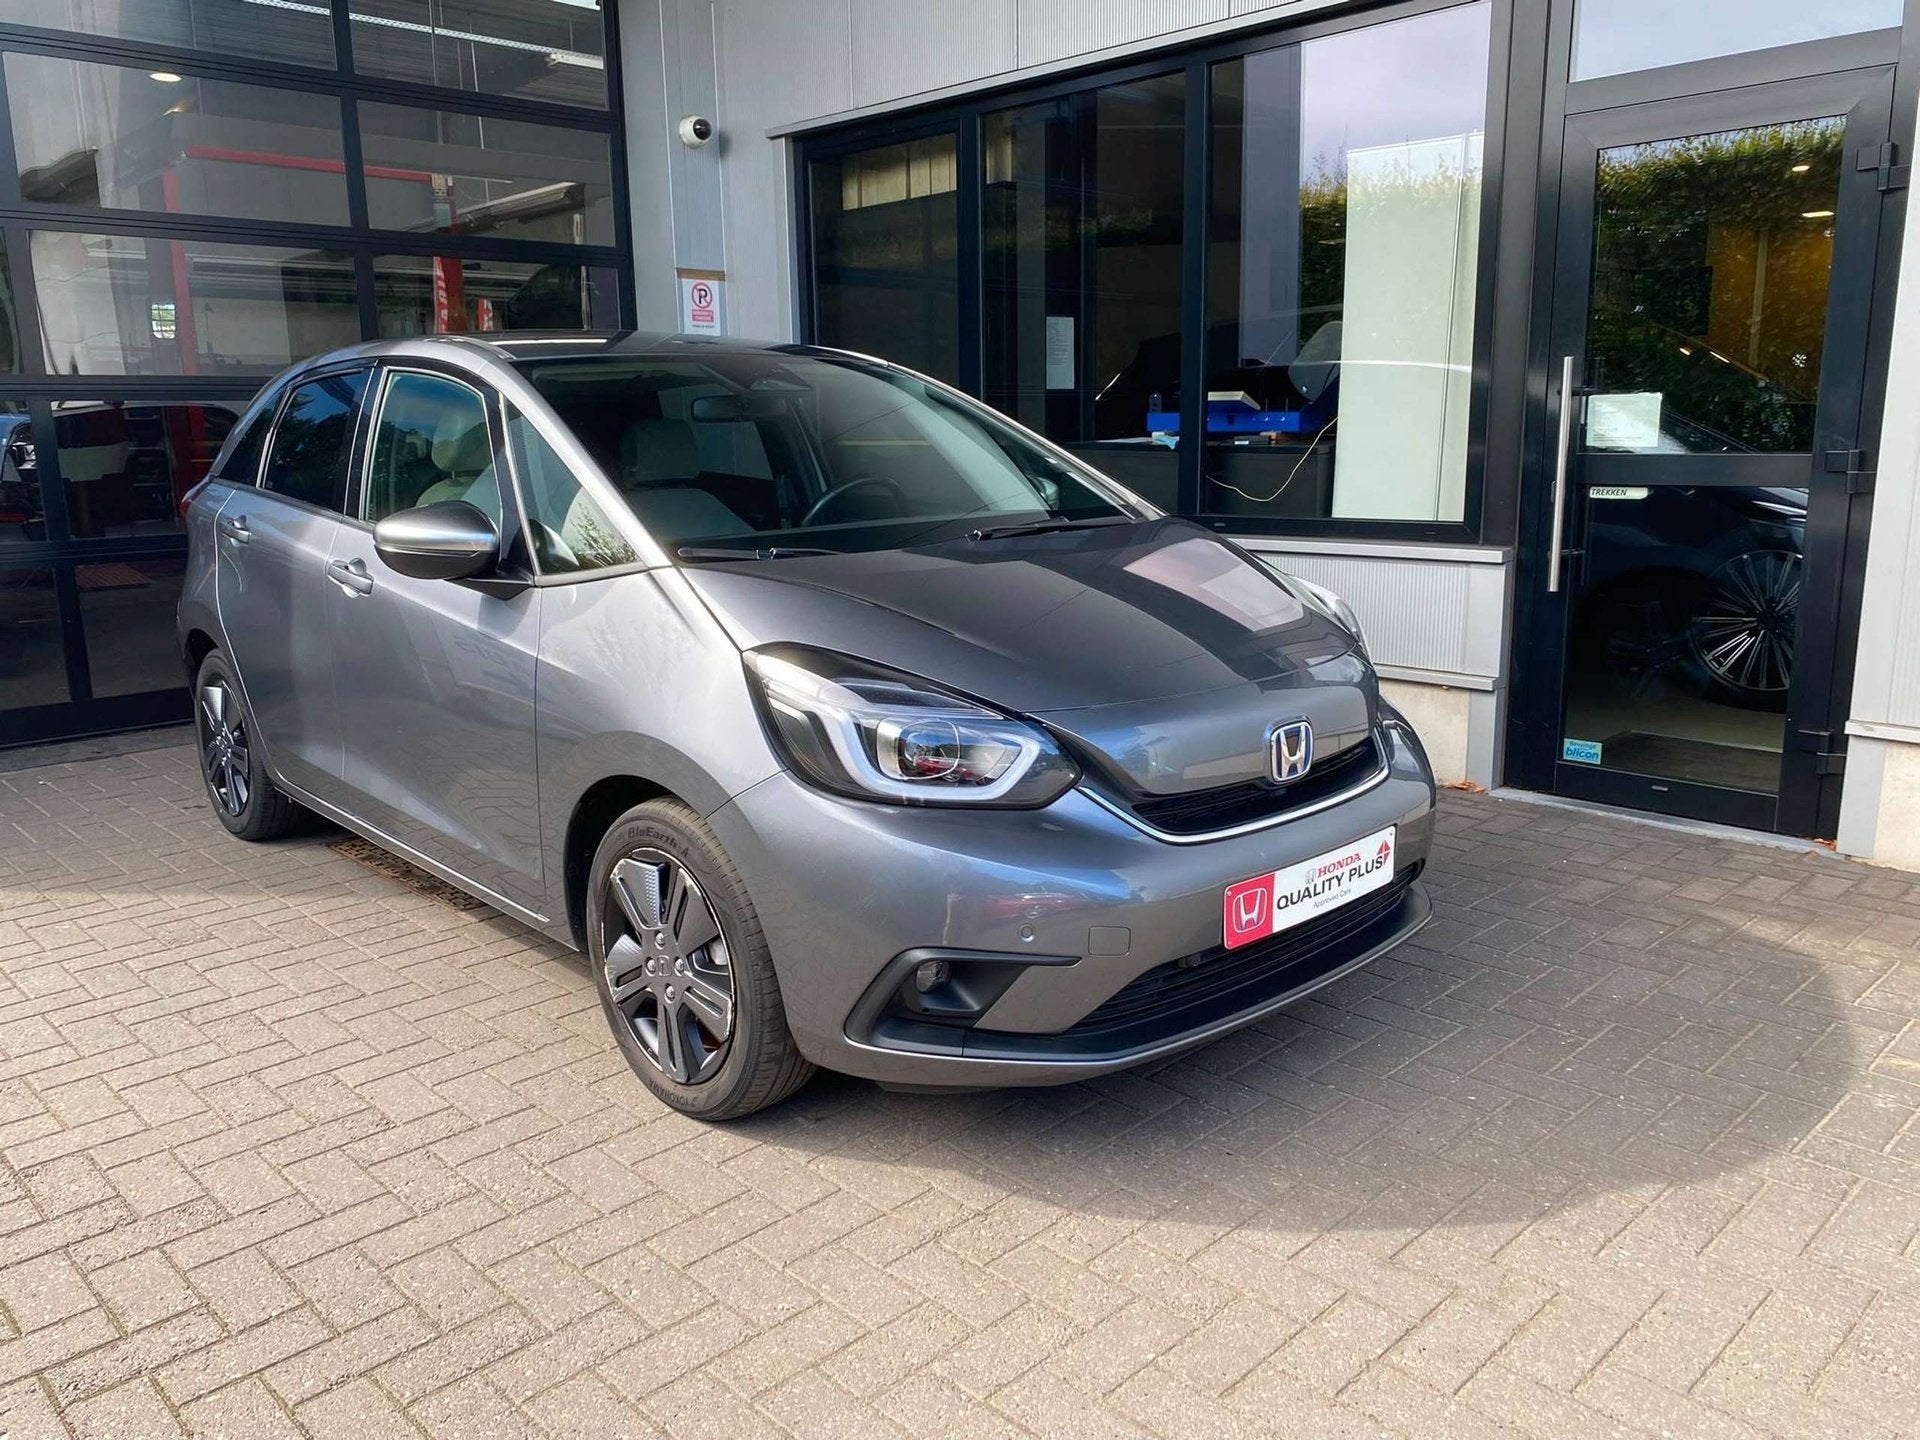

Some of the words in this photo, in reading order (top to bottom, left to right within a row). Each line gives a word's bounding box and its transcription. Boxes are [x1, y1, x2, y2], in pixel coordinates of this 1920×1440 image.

[1591, 488, 1628, 496] TREKKEN
[1566, 747, 1599, 761] blicon
[1317, 853, 1362, 878] HONDA
[1276, 872, 1345, 910] QUALITY
[1348, 856, 1383, 883] PLUS
